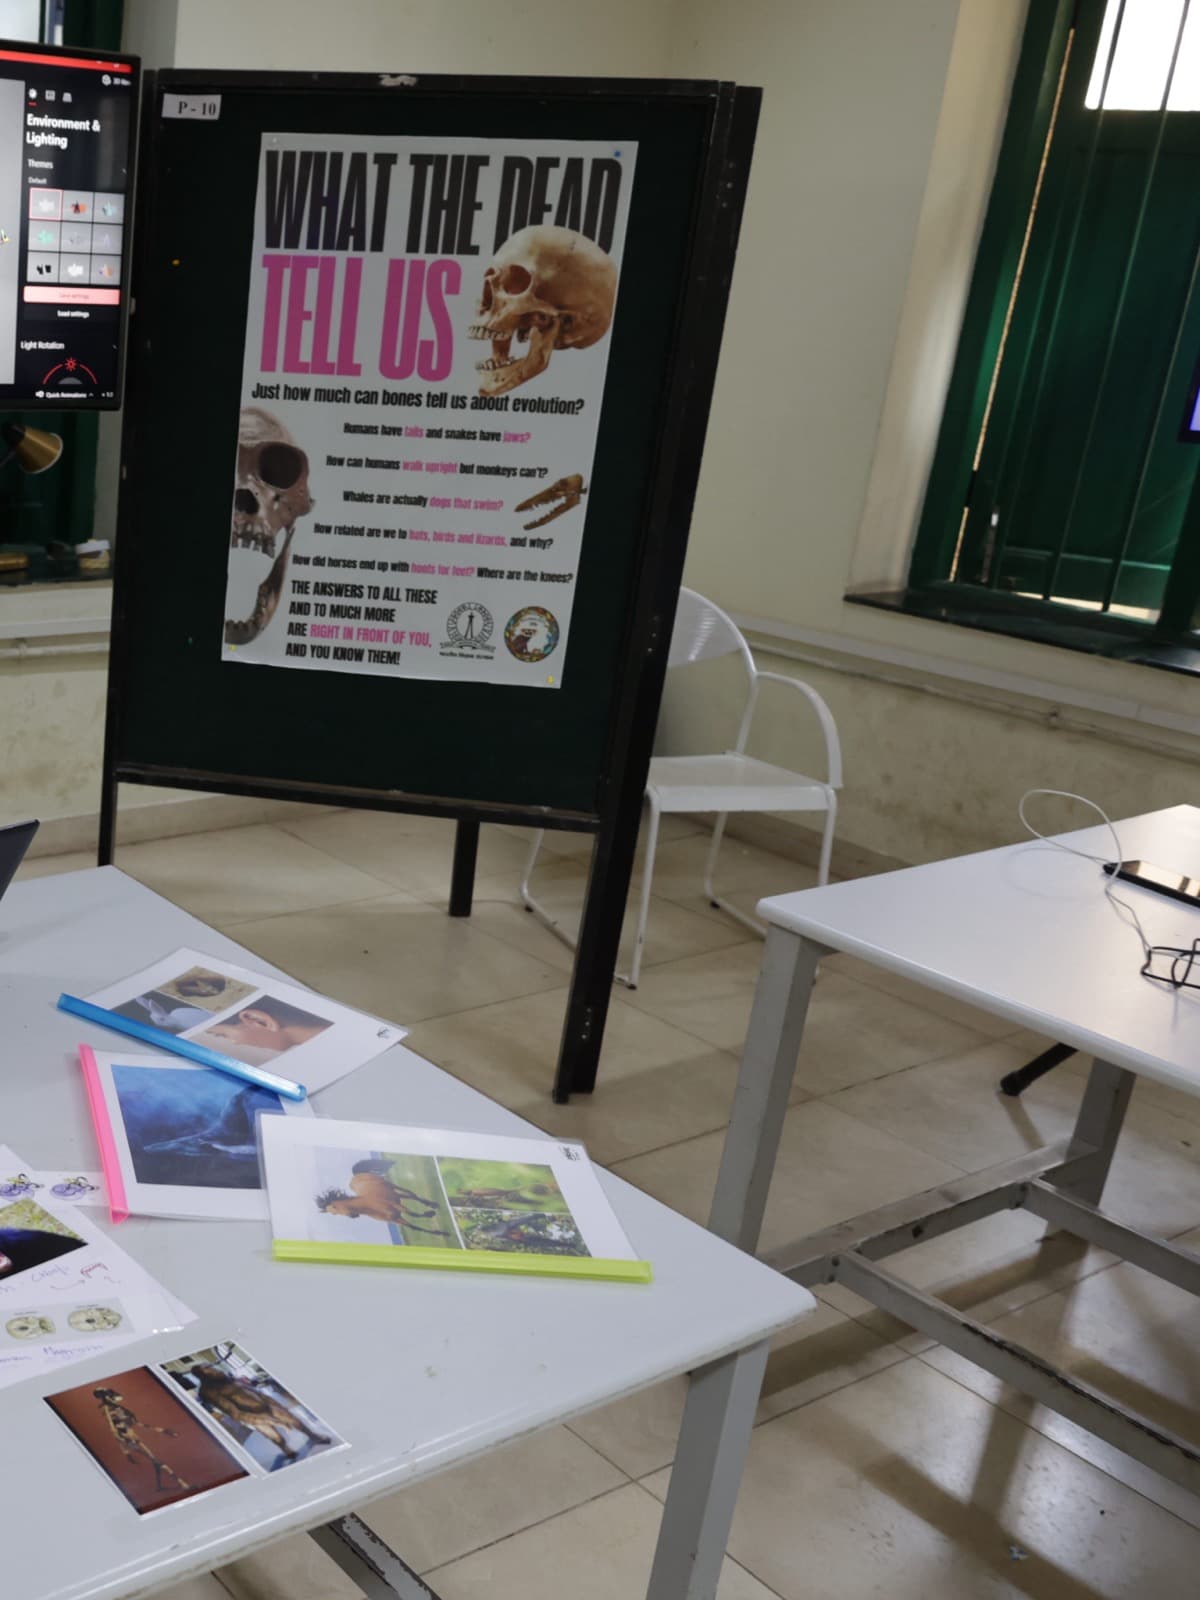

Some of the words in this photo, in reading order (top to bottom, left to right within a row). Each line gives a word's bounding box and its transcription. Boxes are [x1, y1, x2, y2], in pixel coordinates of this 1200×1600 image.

[26, 113, 90, 131] Environment
[91, 119, 101, 132] &
[26, 132, 68, 149] Lighting
[27, 159, 53, 169] Themes
[265, 150, 397, 252] WHAT
[405, 153, 490, 255] THE
[494, 156, 623, 255] DEAD
[260, 254, 363, 377] TELL
[378, 258, 462, 382] US
[20, 341, 37, 351] Light
[38, 341, 65, 350] Rotation
[252, 383, 280, 399] Just
[283, 384, 311, 401] how
[314, 386, 351, 404] much
[354, 389, 378, 405] can
[381, 389, 423, 408] bones
[426, 392, 448, 409] tell
[450, 394, 467, 410] us
[470, 394, 509, 411] about
[512, 396, 585, 415] evolution?
[343, 422, 379, 435] Humans
[381, 424, 403, 437] have
[404, 426, 424, 439] tails
[425, 427, 443, 439] and
[445, 428, 477, 441] snakes
[479, 429, 502, 442] have
[325, 455, 345, 467] How
[346, 457, 363, 468] can
[364, 457, 400, 470] humans
[402, 460, 424, 472] walk
[425, 461, 458, 475] upright
[459, 463, 474, 474] but
[476, 464, 518, 478] monkeys
[343, 490, 374, 502] Whales
[376, 493, 391, 504] are
[392, 493, 428, 508] actually
[429, 496, 452, 509] dogs
[453, 497, 472, 509] that
[473, 499, 504, 511] swim?
[313, 522, 332, 534] How
[334, 524, 365, 536] related
[366, 527, 381, 538] are
[383, 528, 396, 539] we
[398, 528, 407, 540] to
[432, 530, 455, 543] birds
[457, 531, 474, 544] and
[510, 536, 526, 548] and
[529, 537, 554, 550] why?
[292, 554, 310, 566] How
[312, 555, 326, 567] did
[328, 556, 357, 569] horses
[359, 559, 375, 570] end
[377, 561, 389, 573] up
[390, 560, 410, 572] with
[438, 563, 450, 575] for
[452, 565, 475, 577] feet?
[477, 567, 505, 580] Where
[506, 569, 522, 581] are
[523, 569, 538, 582] the
[540, 571, 574, 584] knees?
[291, 580, 311, 595] THE
[313, 581, 365, 599] ANSWERS
[367, 585, 380, 600] TO
[382, 586, 401, 602] ALL
[405, 588, 438, 605] THESE
[289, 601, 311, 616] AND
[314, 603, 327, 617] TO
[329, 604, 362, 620] MUCH
[363, 607, 397, 623] MORE
[287, 622, 308, 637] ARE
[310, 624, 340, 640] RIGHT
[342, 625, 354, 640] IN
[356, 626, 391, 643] FRONT
[392, 630, 406, 645] OF
[286, 642, 307, 657] AND
[310, 644, 331, 659] YOU
[332, 647, 364, 662] KNOW
[367, 649, 401, 665] THEM!
